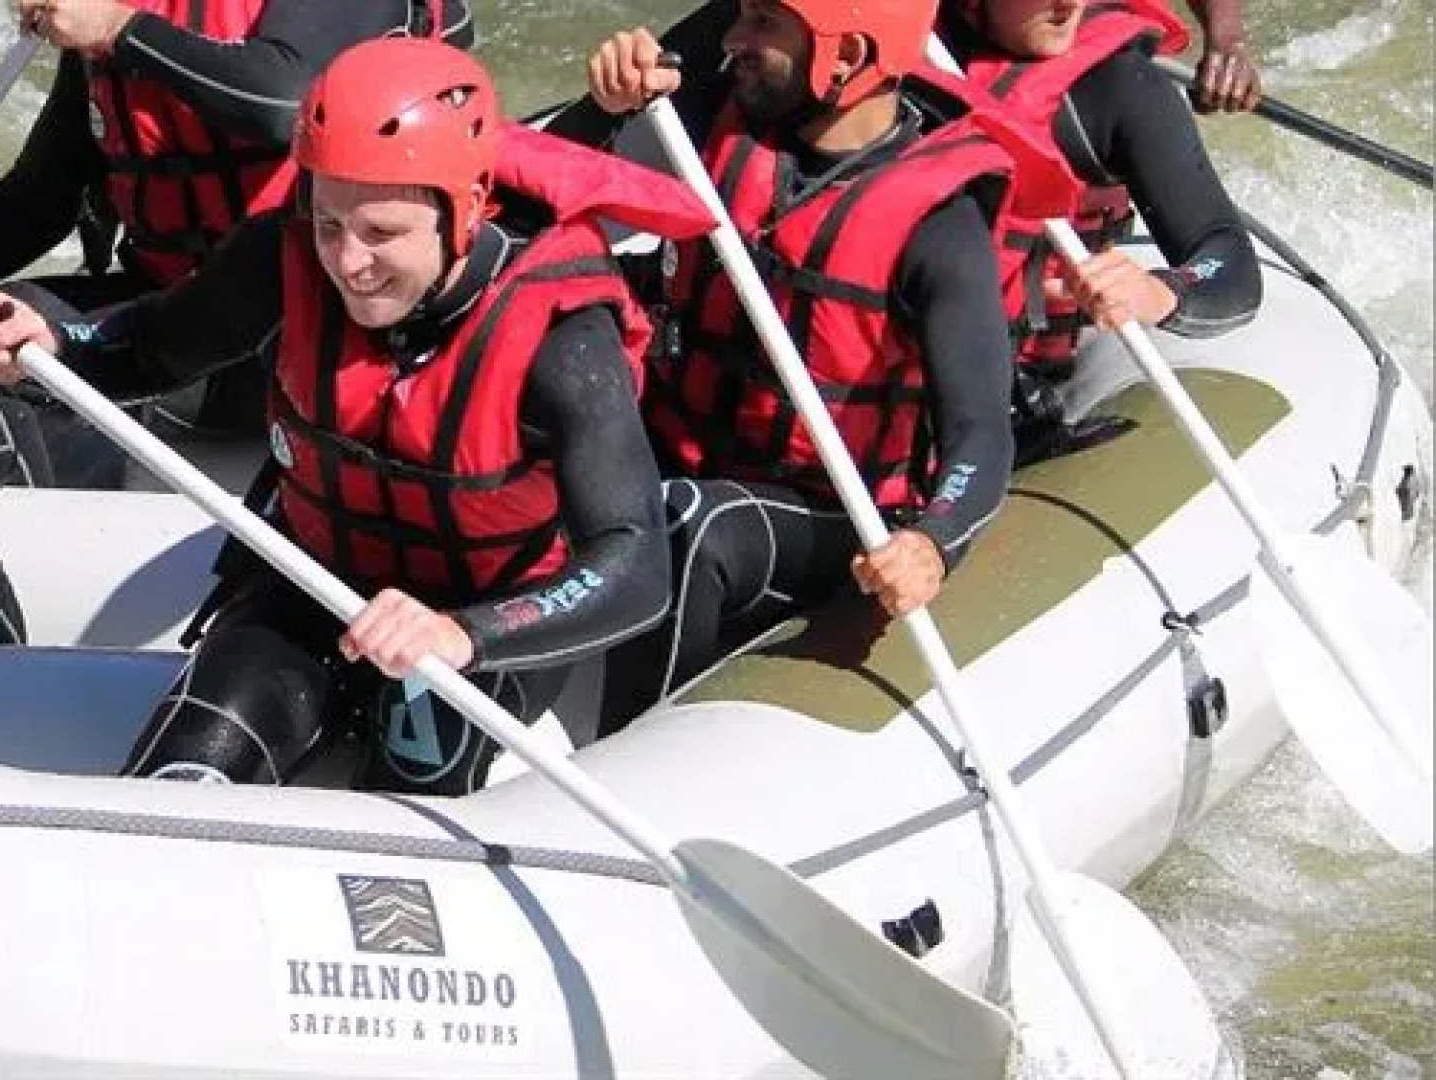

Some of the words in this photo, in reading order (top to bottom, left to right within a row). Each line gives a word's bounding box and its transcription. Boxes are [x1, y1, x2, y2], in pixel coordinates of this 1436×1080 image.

[286, 958, 517, 1010] KHANONDO
[289, 1012, 397, 1040] SAFARIS
[412, 1018, 427, 1041] &
[441, 1021, 518, 1047] TOURS
